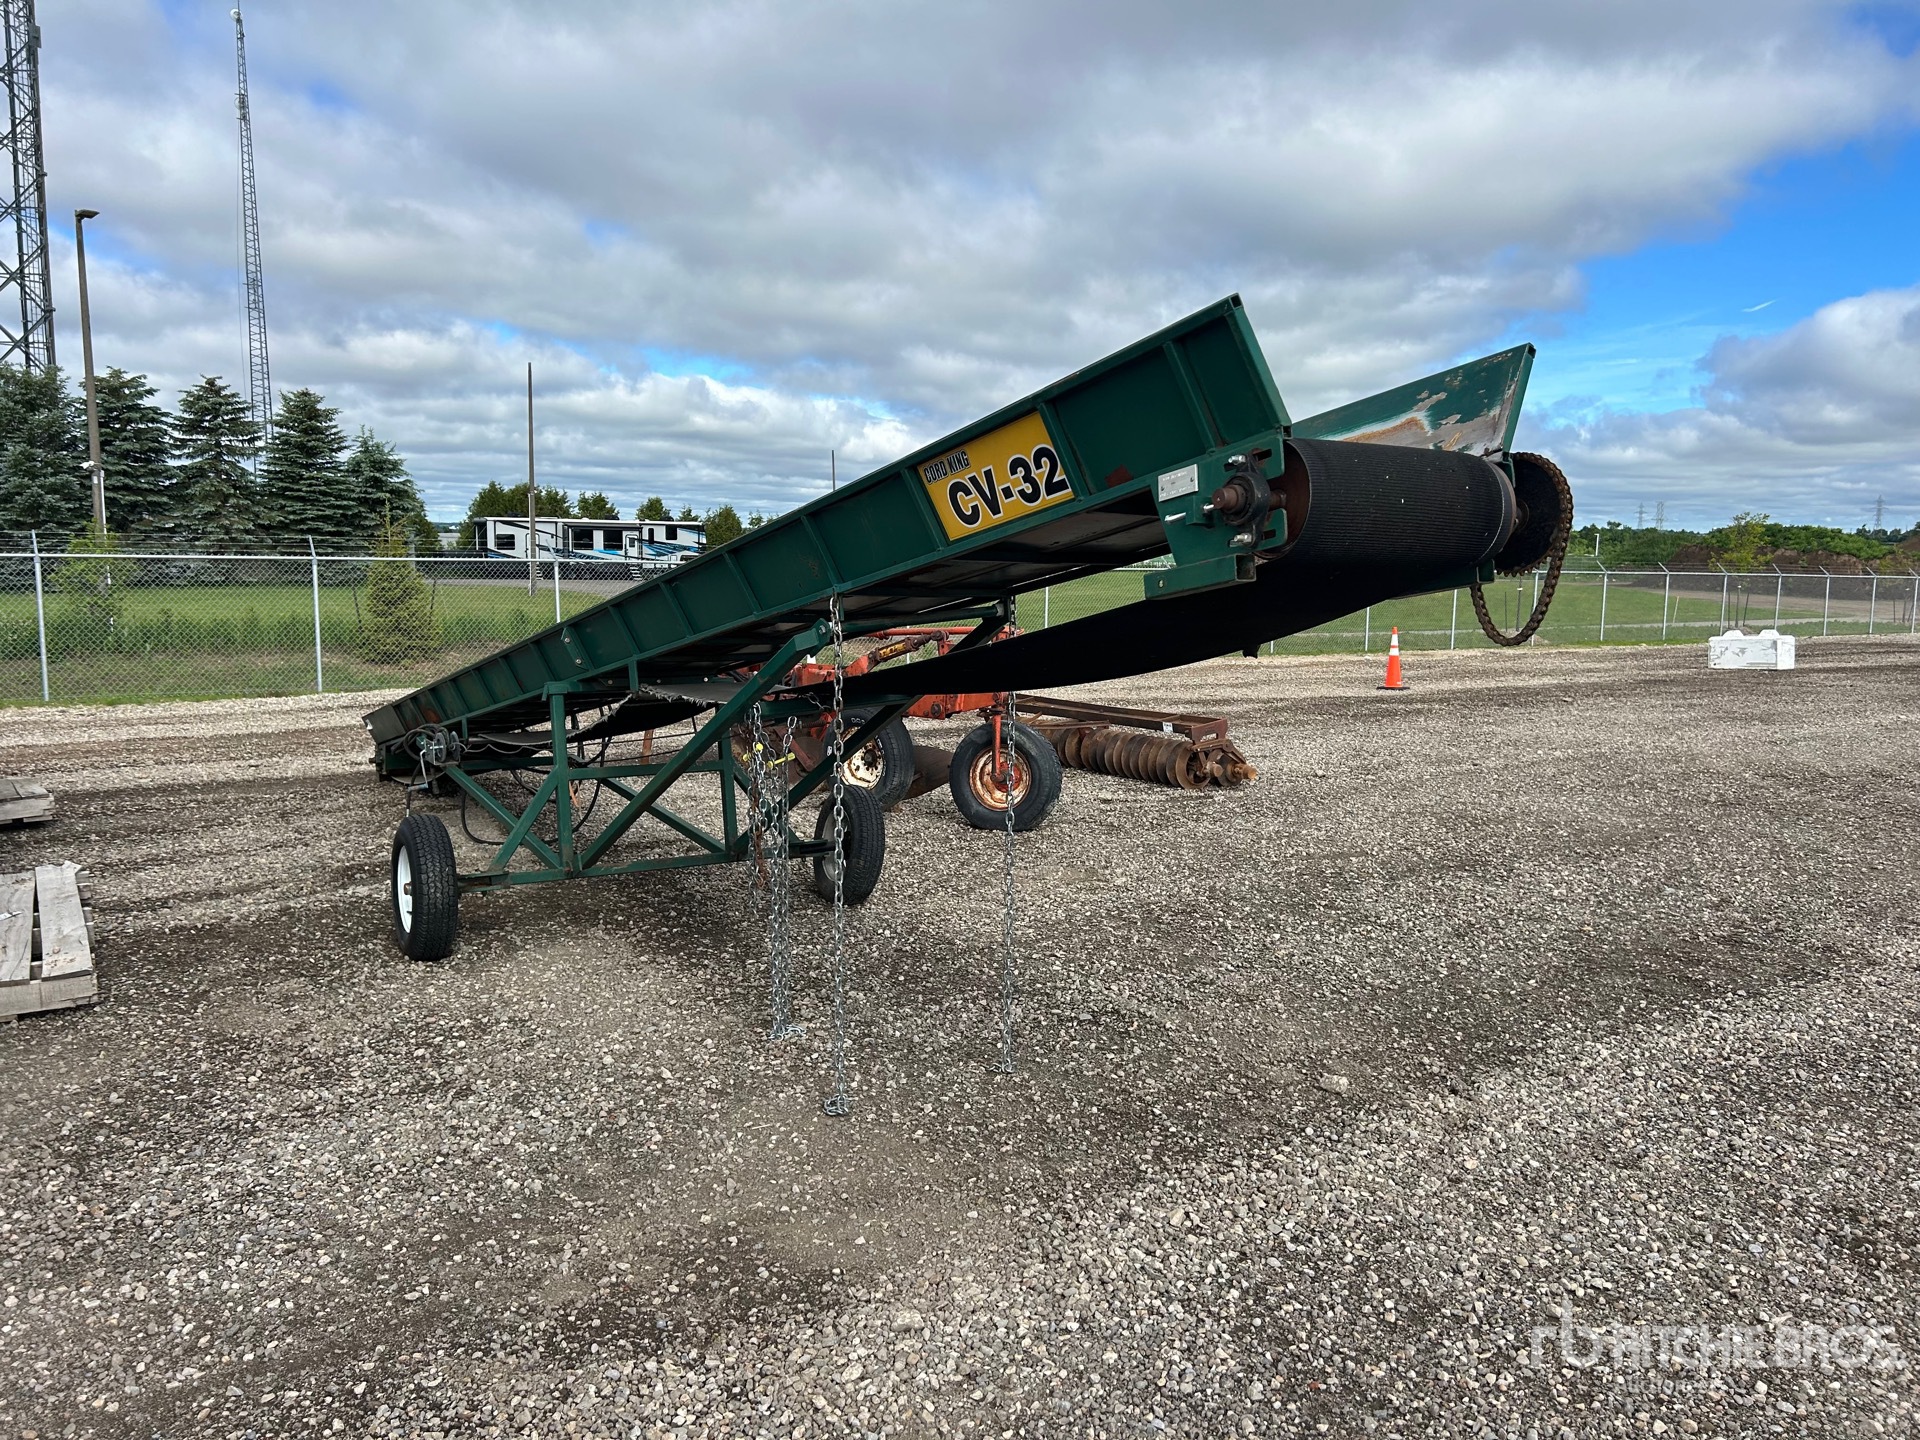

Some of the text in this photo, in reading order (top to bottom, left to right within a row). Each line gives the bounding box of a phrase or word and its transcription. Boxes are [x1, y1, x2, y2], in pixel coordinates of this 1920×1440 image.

[923, 449, 971, 484] CORD KING
[947, 444, 1072, 528] CV-32
